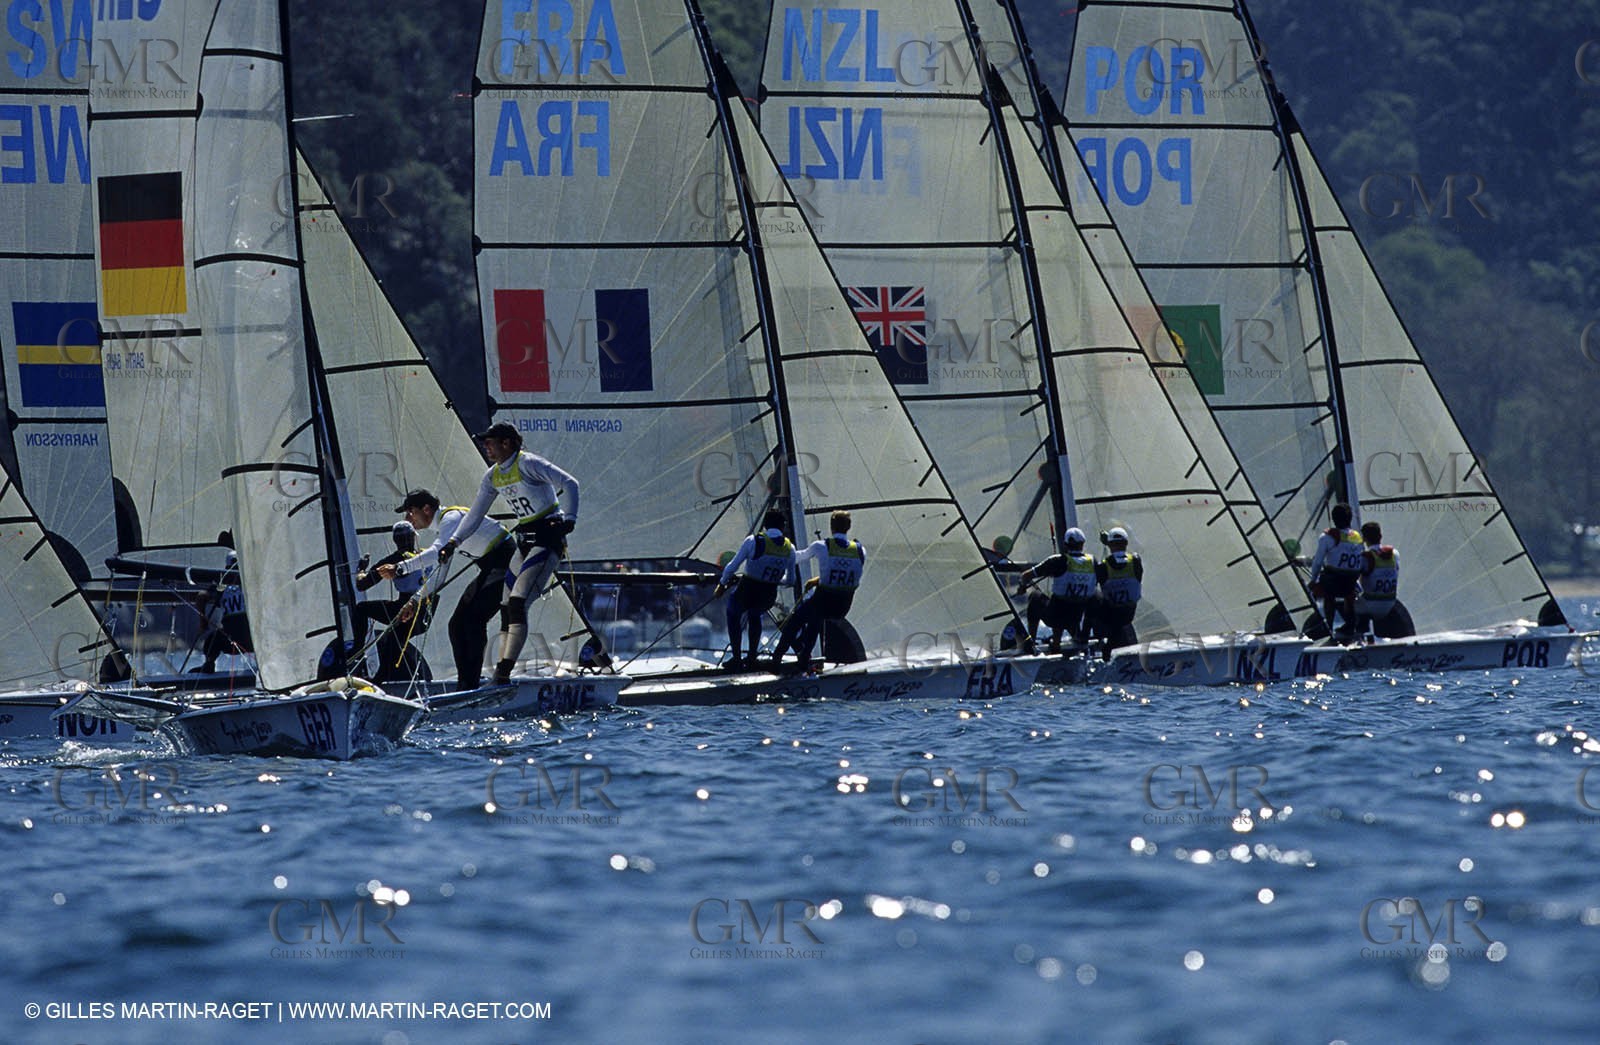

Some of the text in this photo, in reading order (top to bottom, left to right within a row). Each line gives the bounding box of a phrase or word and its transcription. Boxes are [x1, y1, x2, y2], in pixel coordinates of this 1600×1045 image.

[502, 0, 627, 76] FRA
[782, 8, 897, 83] NZL
[1086, 46, 1206, 116] POR
[829, 569, 856, 585] FRA
[843, 681, 894, 700] Sydney
[964, 663, 1014, 698] FRA
[296, 703, 338, 751] GER
